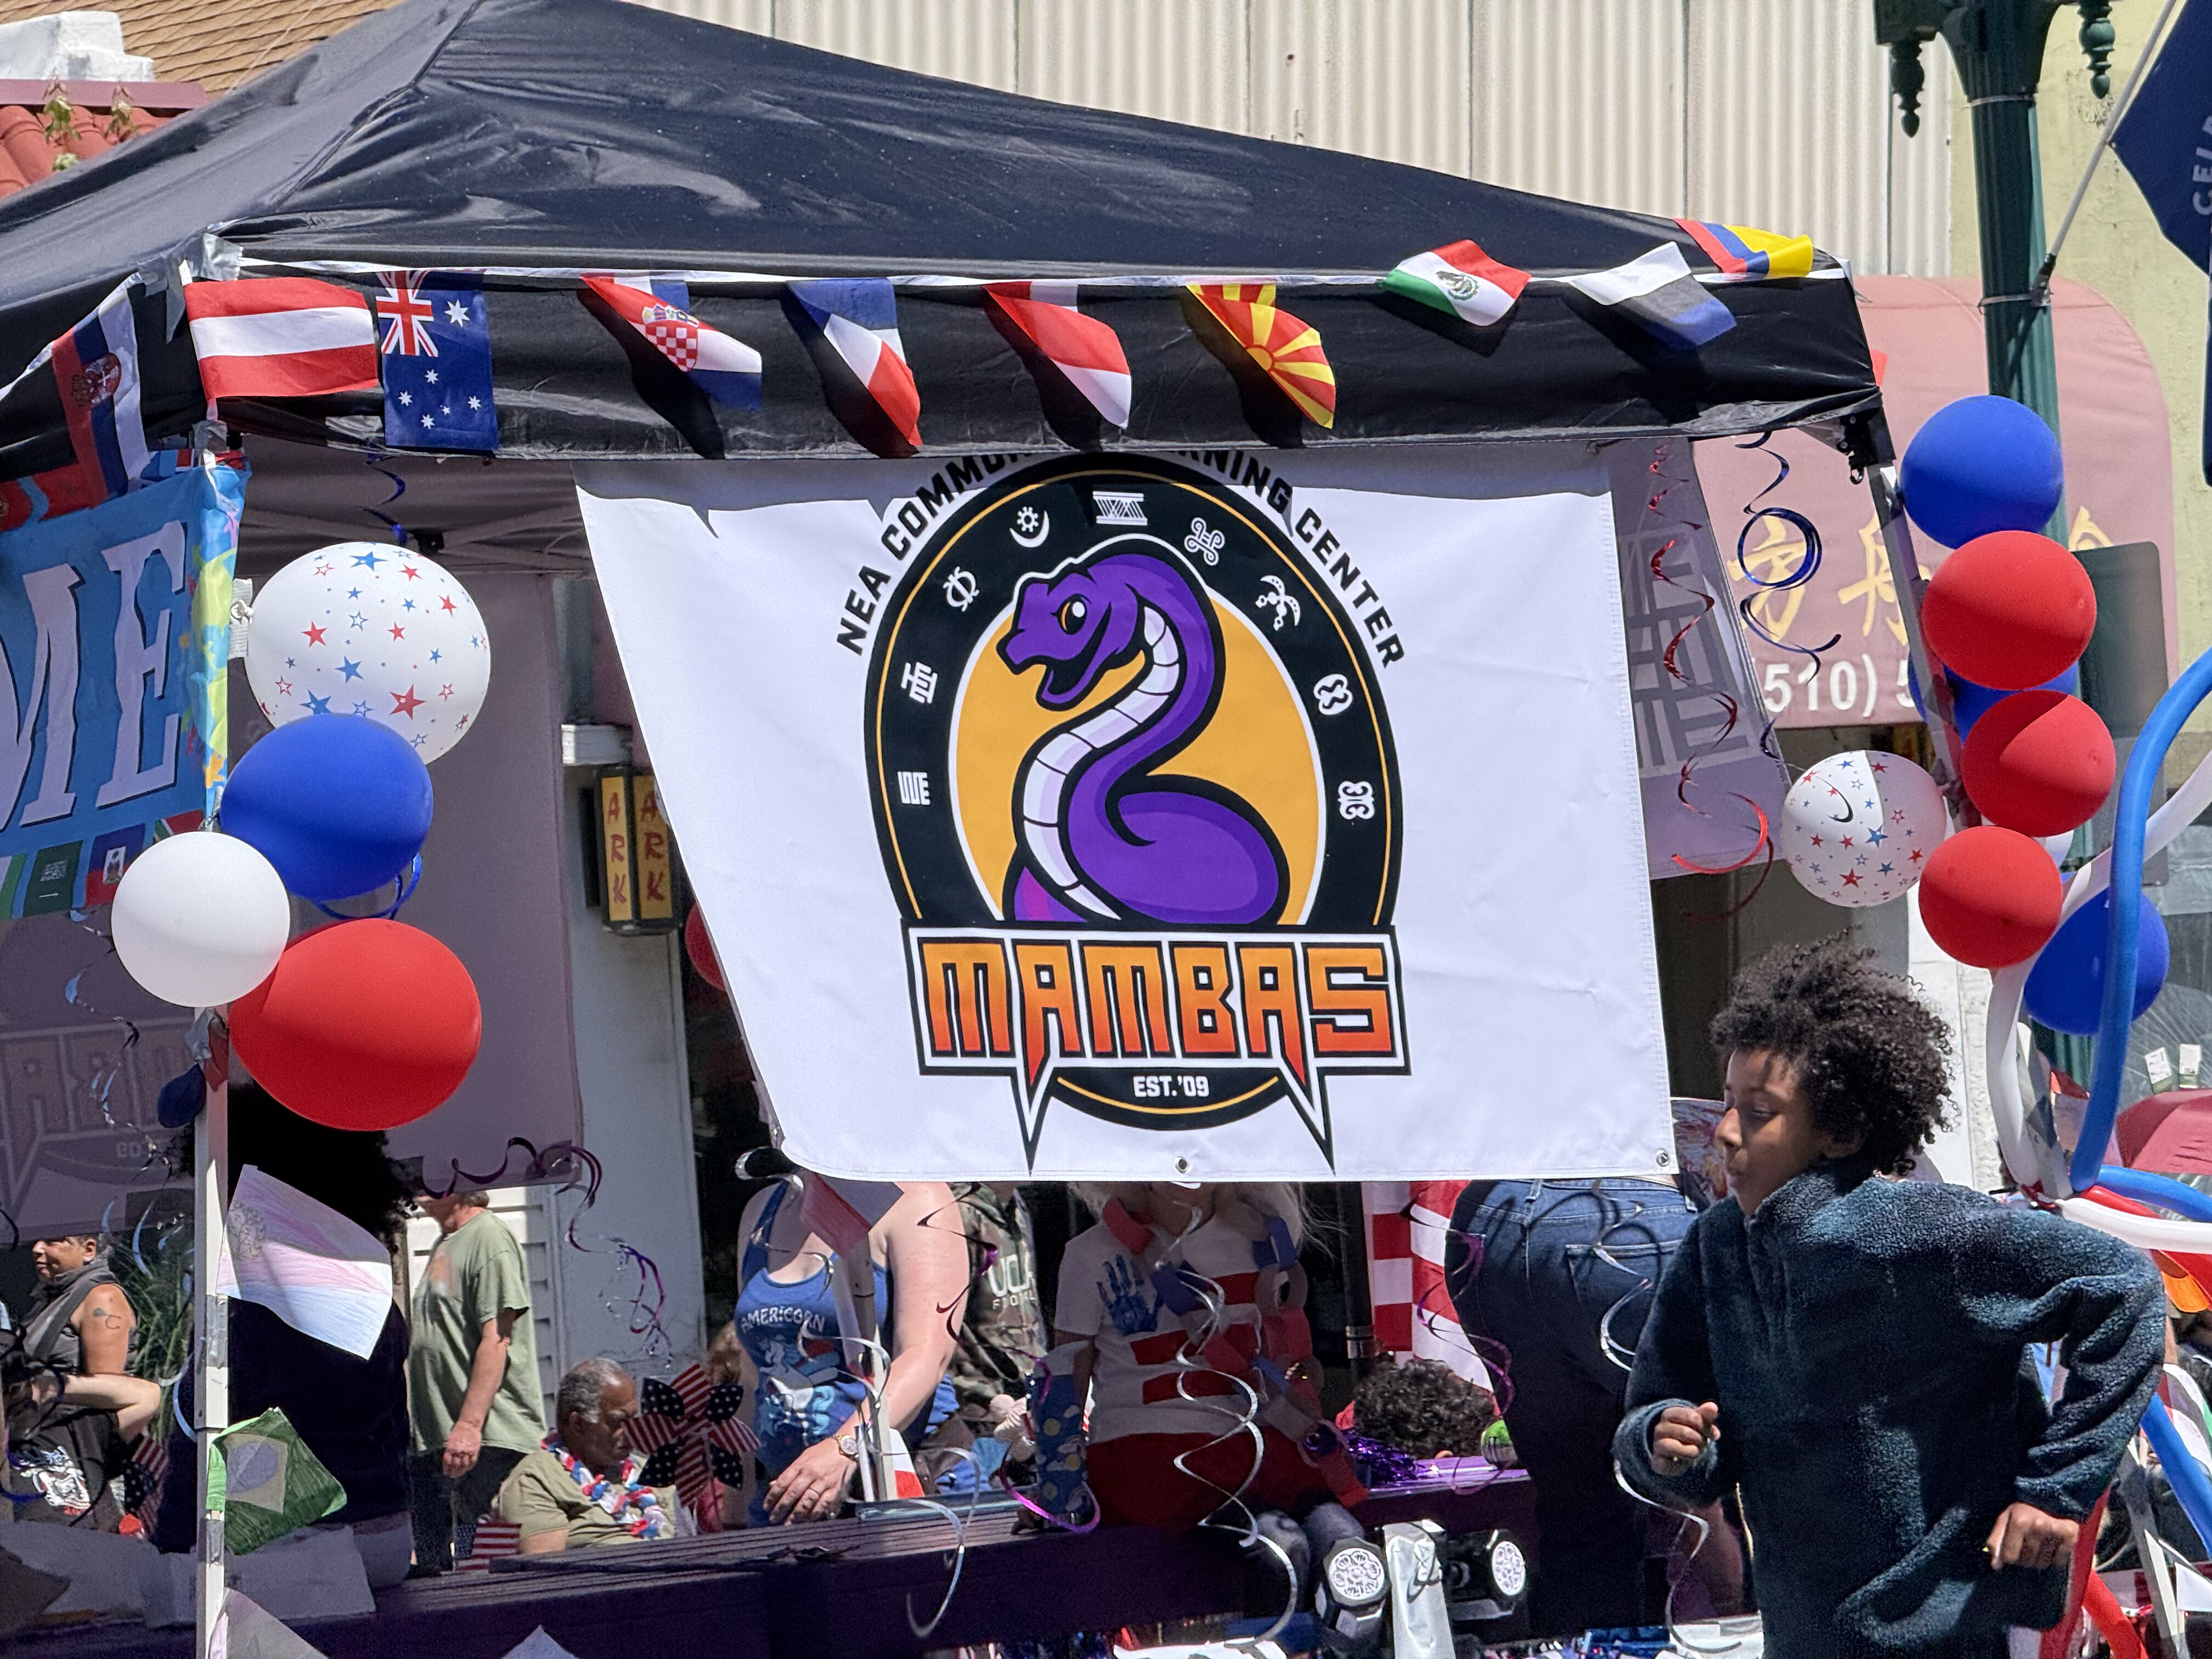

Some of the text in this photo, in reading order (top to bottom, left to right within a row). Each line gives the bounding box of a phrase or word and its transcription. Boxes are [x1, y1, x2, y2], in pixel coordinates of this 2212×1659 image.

[837, 565, 891, 657] NEA
[881, 453, 1031, 561] COMMU
[1295, 507, 1404, 669] CENTER
[1763, 654, 1877, 717] 510)
[607, 792, 627, 904] ARK
[640, 789, 665, 901] ARK
[918, 938, 1396, 1087] MAMBAS
